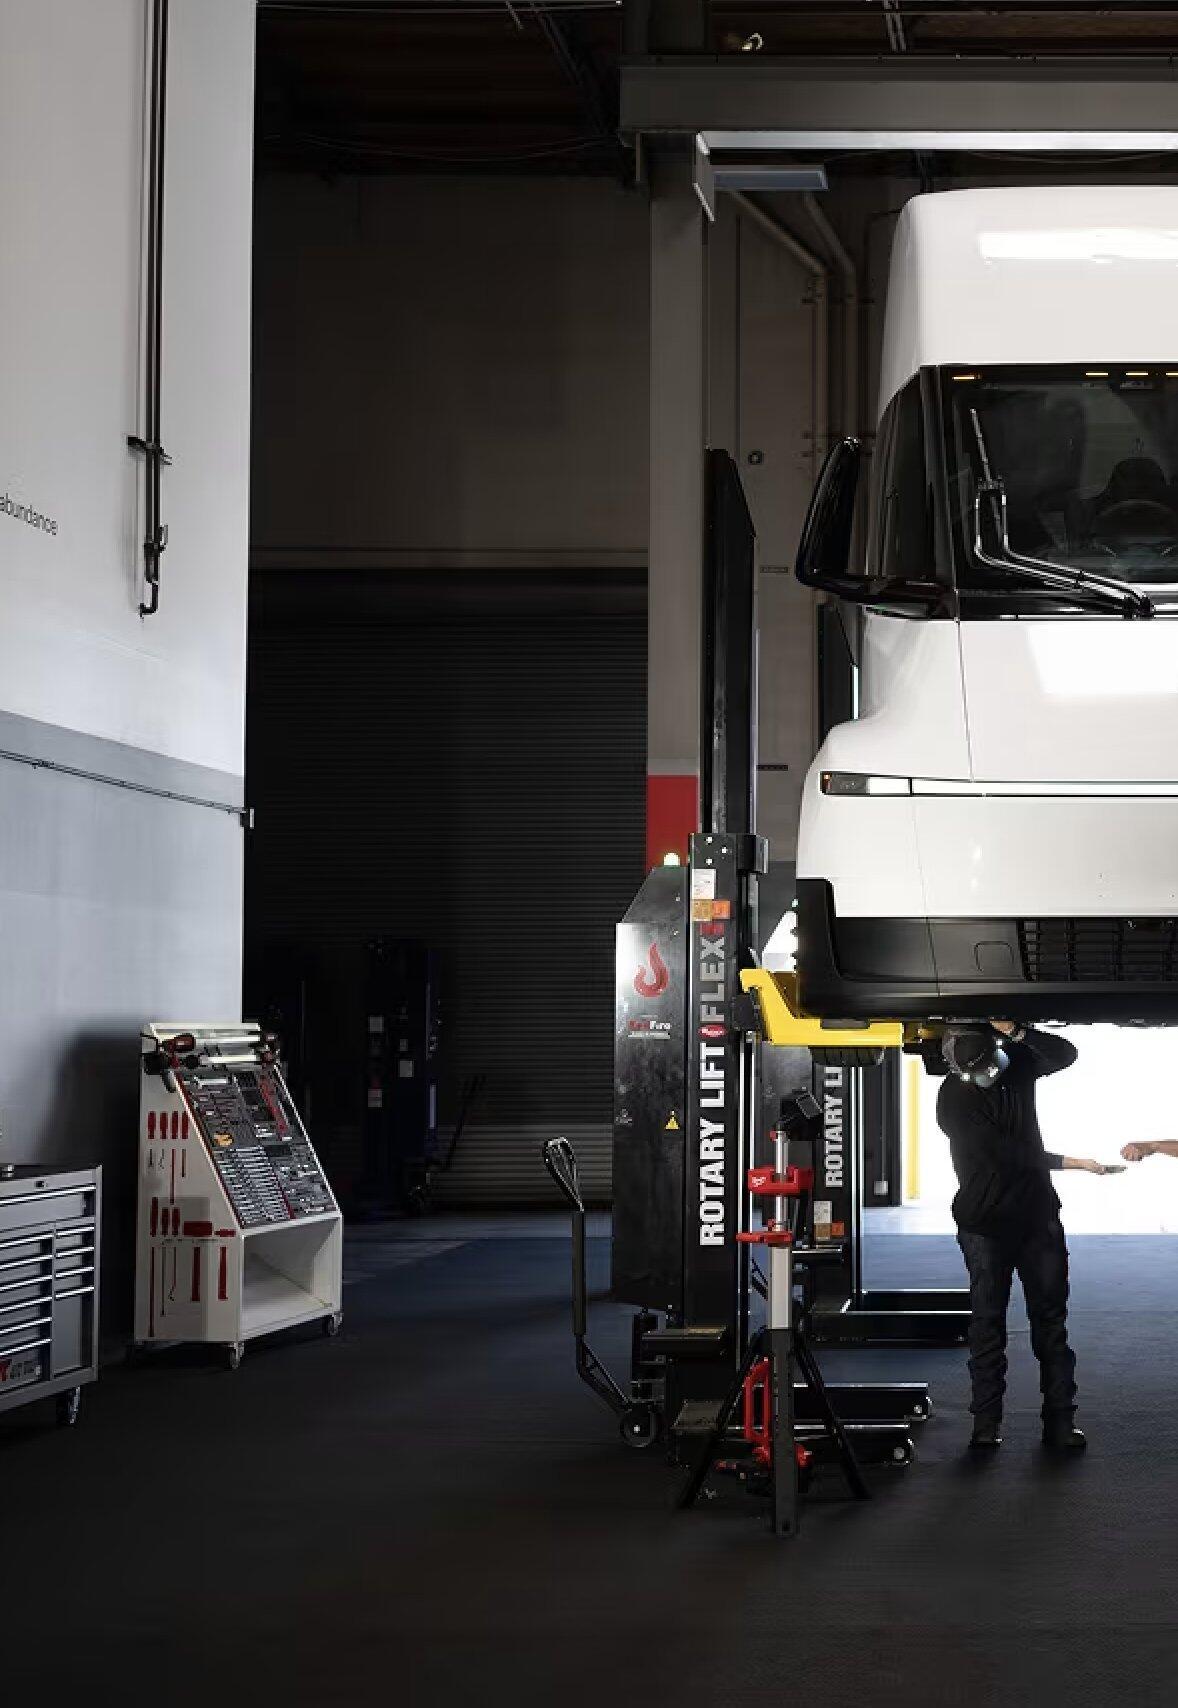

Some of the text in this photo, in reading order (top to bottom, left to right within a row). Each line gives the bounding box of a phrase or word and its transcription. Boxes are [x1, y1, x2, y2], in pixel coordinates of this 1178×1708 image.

[0, 493, 58, 536] abundance
[699, 936, 725, 1022] FLEX
[699, 1042, 725, 1108] LIFT
[699, 1117, 725, 1246] ROTARY
[823, 1093, 843, 1188] ROTARY
